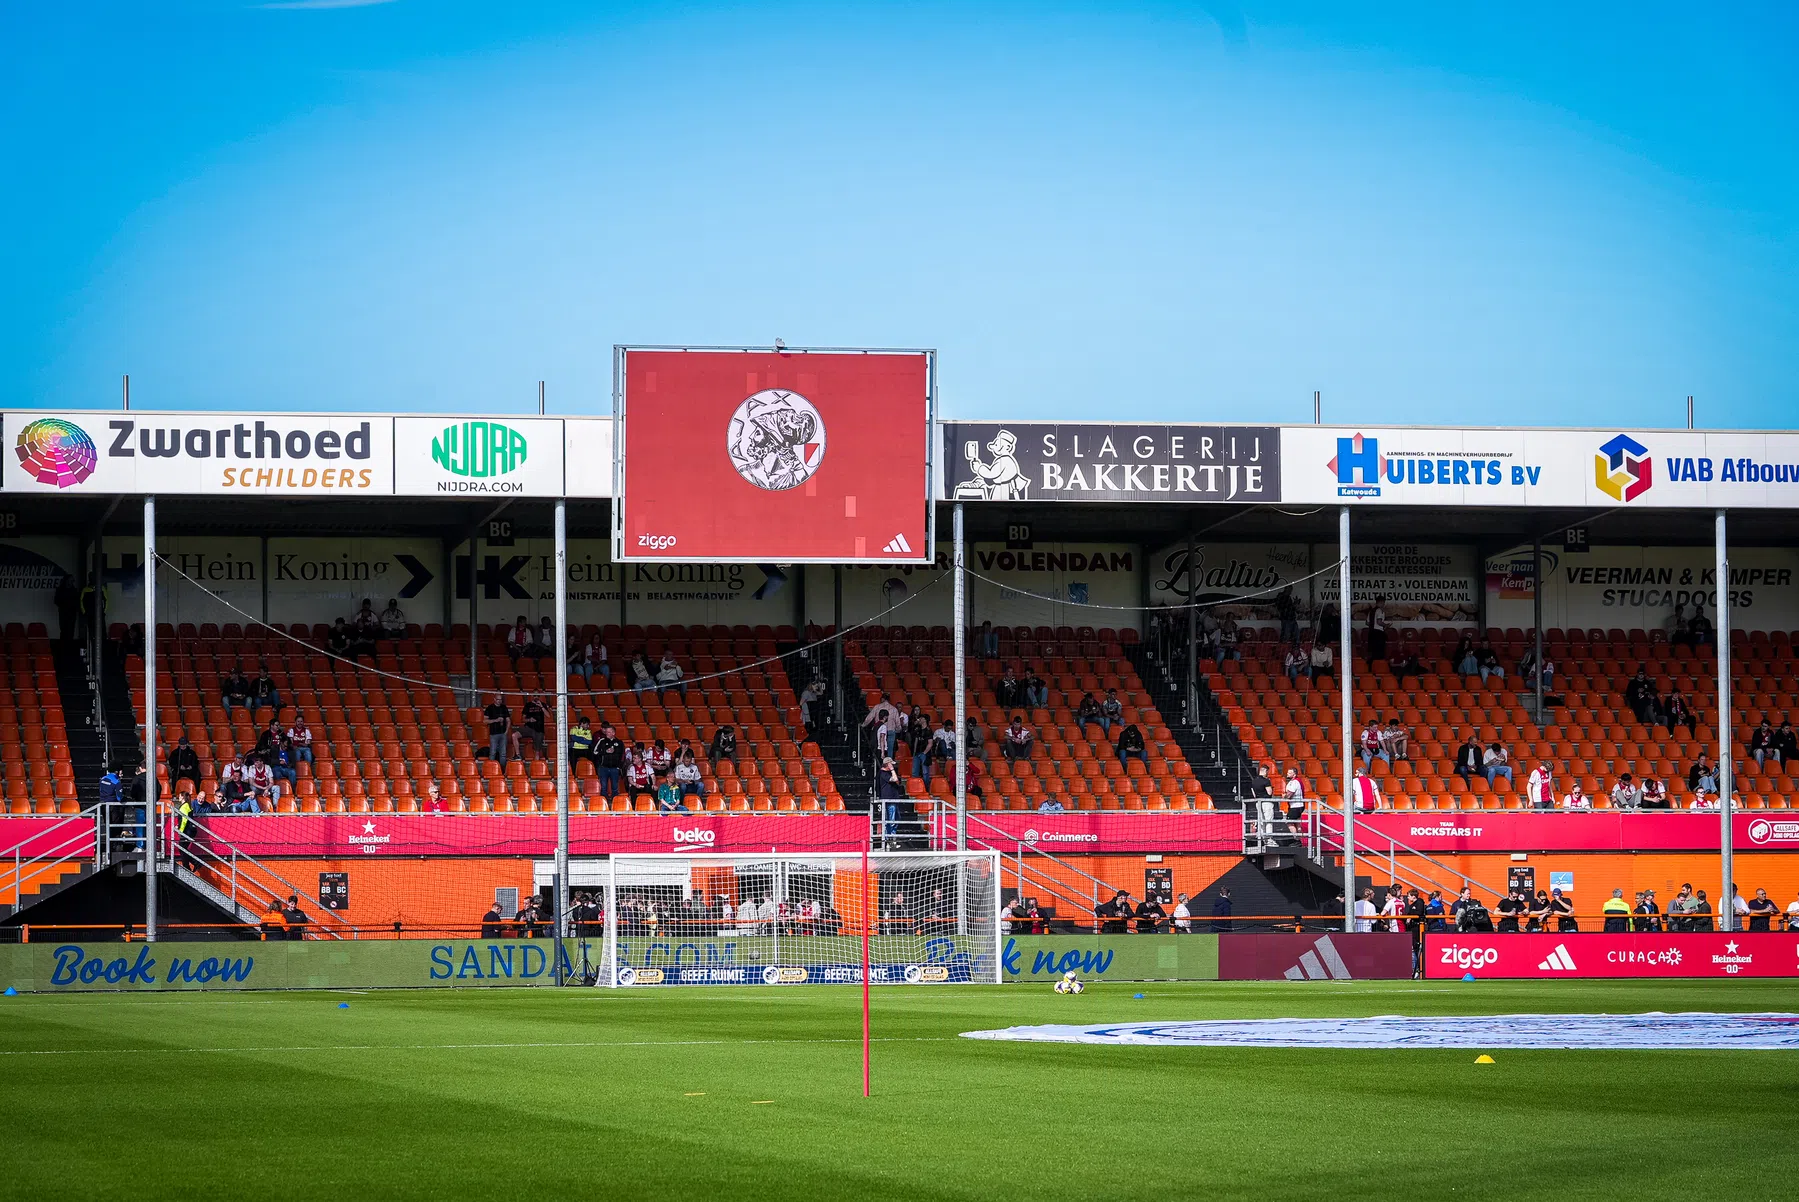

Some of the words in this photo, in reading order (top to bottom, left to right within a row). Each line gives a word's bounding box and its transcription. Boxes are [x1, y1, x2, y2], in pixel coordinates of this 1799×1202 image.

[732, 391, 791, 462] AJAX
[108, 420, 371, 459] Zwarthoed
[432, 422, 527, 477] NIJDRA
[1042, 434, 1259, 462] SLAGERIJ
[222, 467, 372, 488] SCHILDERS
[1511, 466, 1541, 486] BV
[1667, 458, 1713, 482] VAB
[437, 482, 523, 493] NIJDRA.COM
[1040, 462, 1263, 500] BAKKERTJE
[1341, 488, 1378, 496] Katwoude
[489, 521, 512, 537] BC
[1008, 525, 1030, 540] BD
[1566, 529, 1585, 543] BE
[638, 534, 677, 549] ziggo
[1373, 546, 1402, 555] VOOR
[1405, 546, 1418, 555] DE
[178, 553, 256, 581] Hein
[977, 551, 1133, 572] VOLENDAM
[1351, 556, 1395, 565] KKERSTE
[1398, 556, 1451, 566] BROODJES
[1486, 562, 1534, 573] Veerman
[0, 564, 39, 577] AKMAN
[41, 564, 55, 577] BV
[1155, 545, 1288, 597] Baltus
[1567, 567, 1673, 585] VEERMAN
[1679, 569, 1693, 585] &
[1701, 568, 1792, 586] KMPER
[0, 578, 61, 589] ENTVLOERE
[1324, 580, 1387, 589] ZETRAAT
[1389, 580, 1395, 589] 3
[1405, 580, 1468, 590] VOLENDAM
[1501, 578, 1544, 591] Kemp
[540, 592, 620, 600] ADINISTRATIE
[1321, 591, 1471, 601] WW.BALTUSVOLENDAM.NL
[348, 834, 391, 844] Heineken
[673, 827, 716, 843] beko
[1042, 831, 1098, 842] Coinmerce
[1410, 827, 1472, 836] ROCKSTARS
[1473, 828, 1482, 836] IT
[1031, 949, 1113, 975] now
[1441, 943, 1498, 969] ziggo
[1712, 954, 1753, 963] Heineken
[50, 944, 156, 985] Book
[166, 957, 254, 983] now
[854, 969, 888, 981] RMTE
